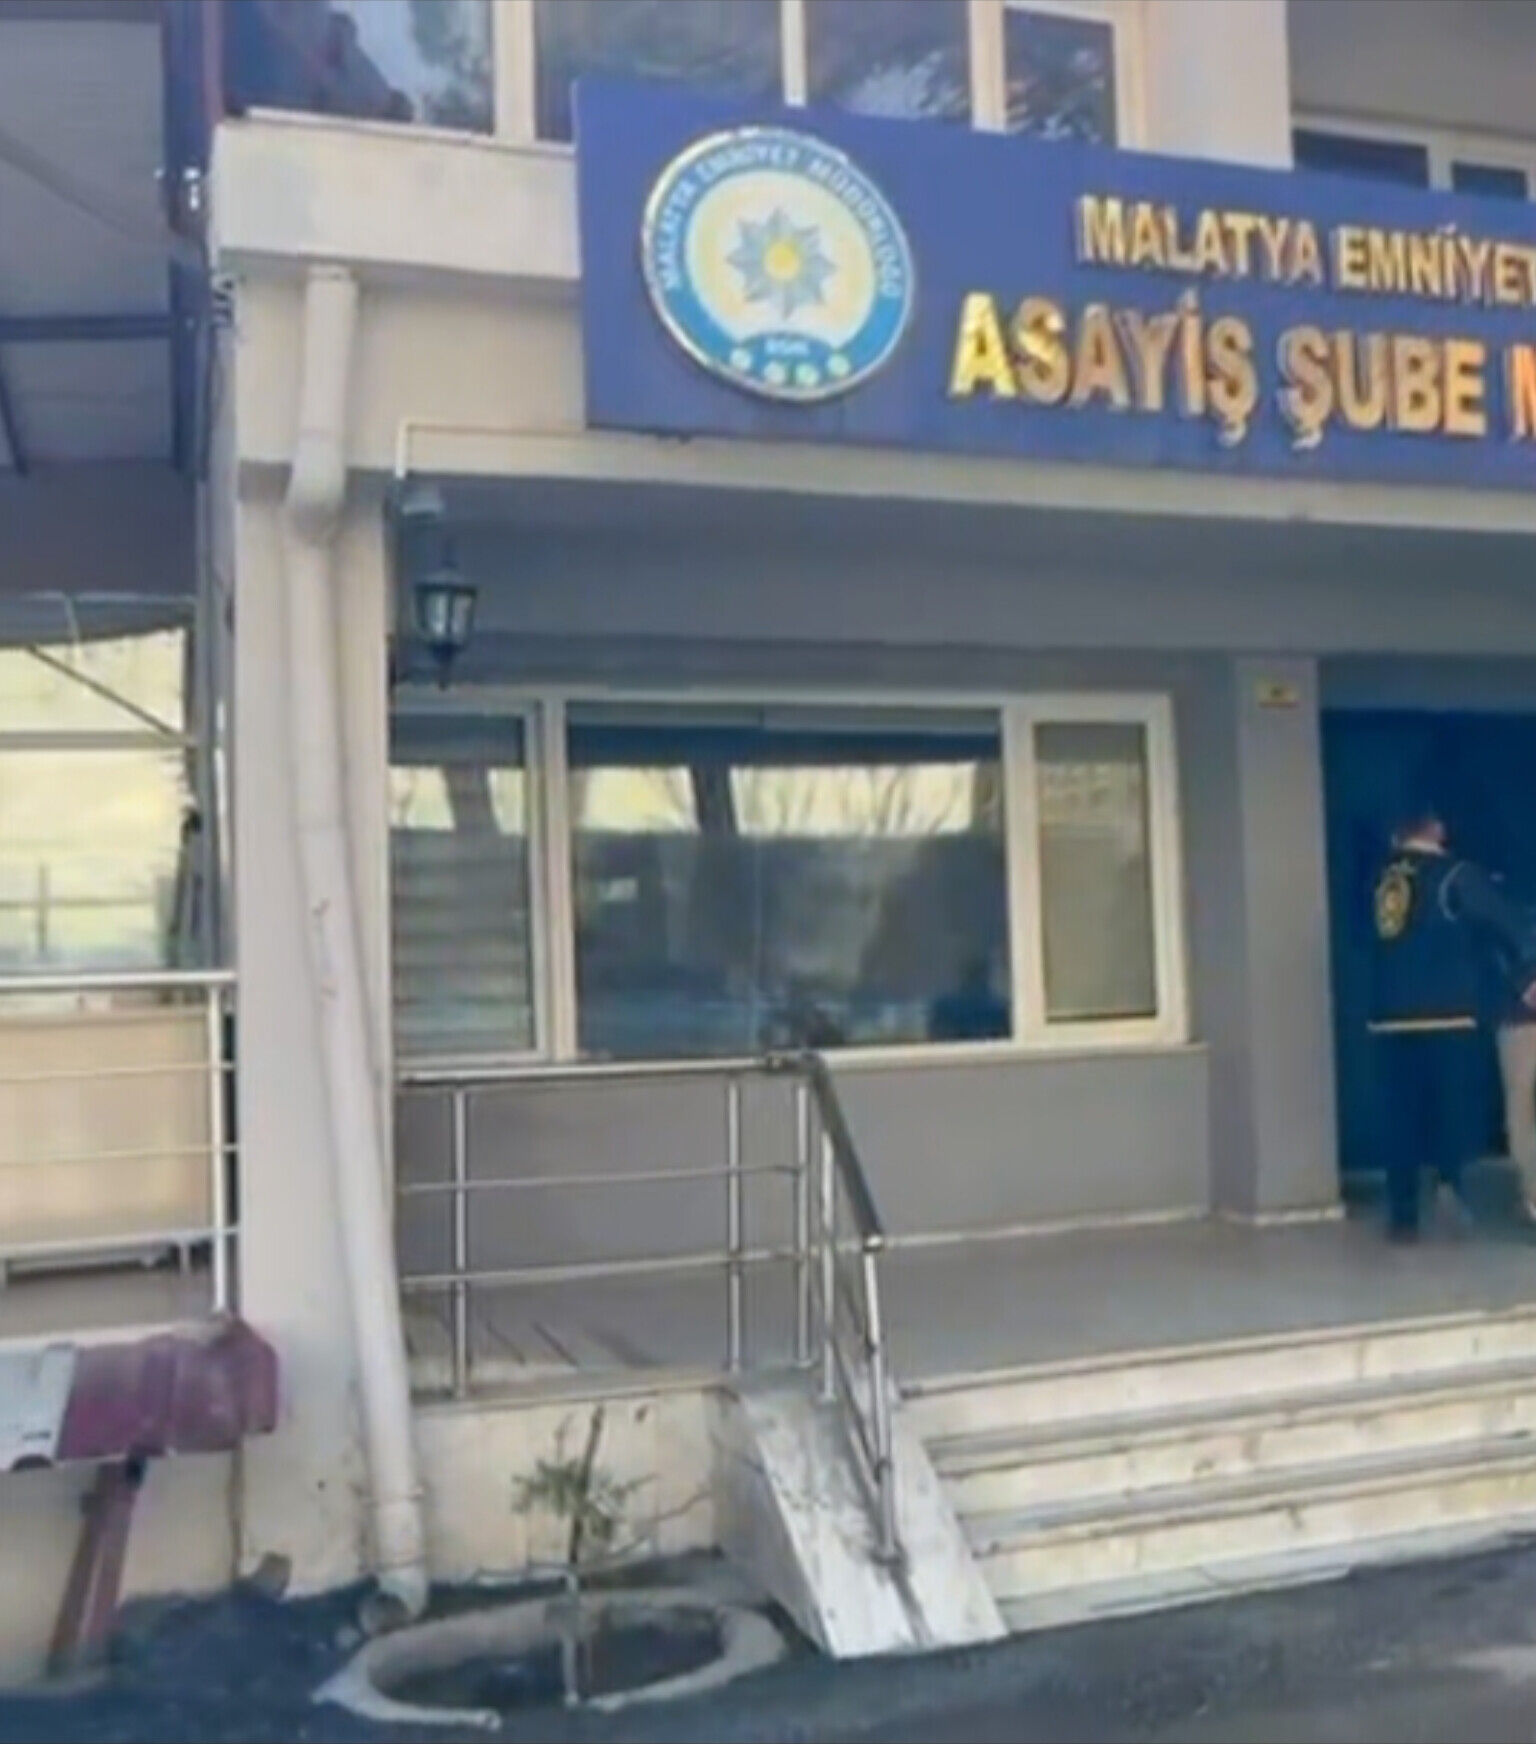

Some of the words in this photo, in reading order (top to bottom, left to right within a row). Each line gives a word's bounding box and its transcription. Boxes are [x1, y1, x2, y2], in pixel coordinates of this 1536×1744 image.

[1078, 194, 1325, 285] MALATYA
[951, 289, 1257, 447] ASAYİŞ
[1278, 326, 1486, 448] ŞUBE
